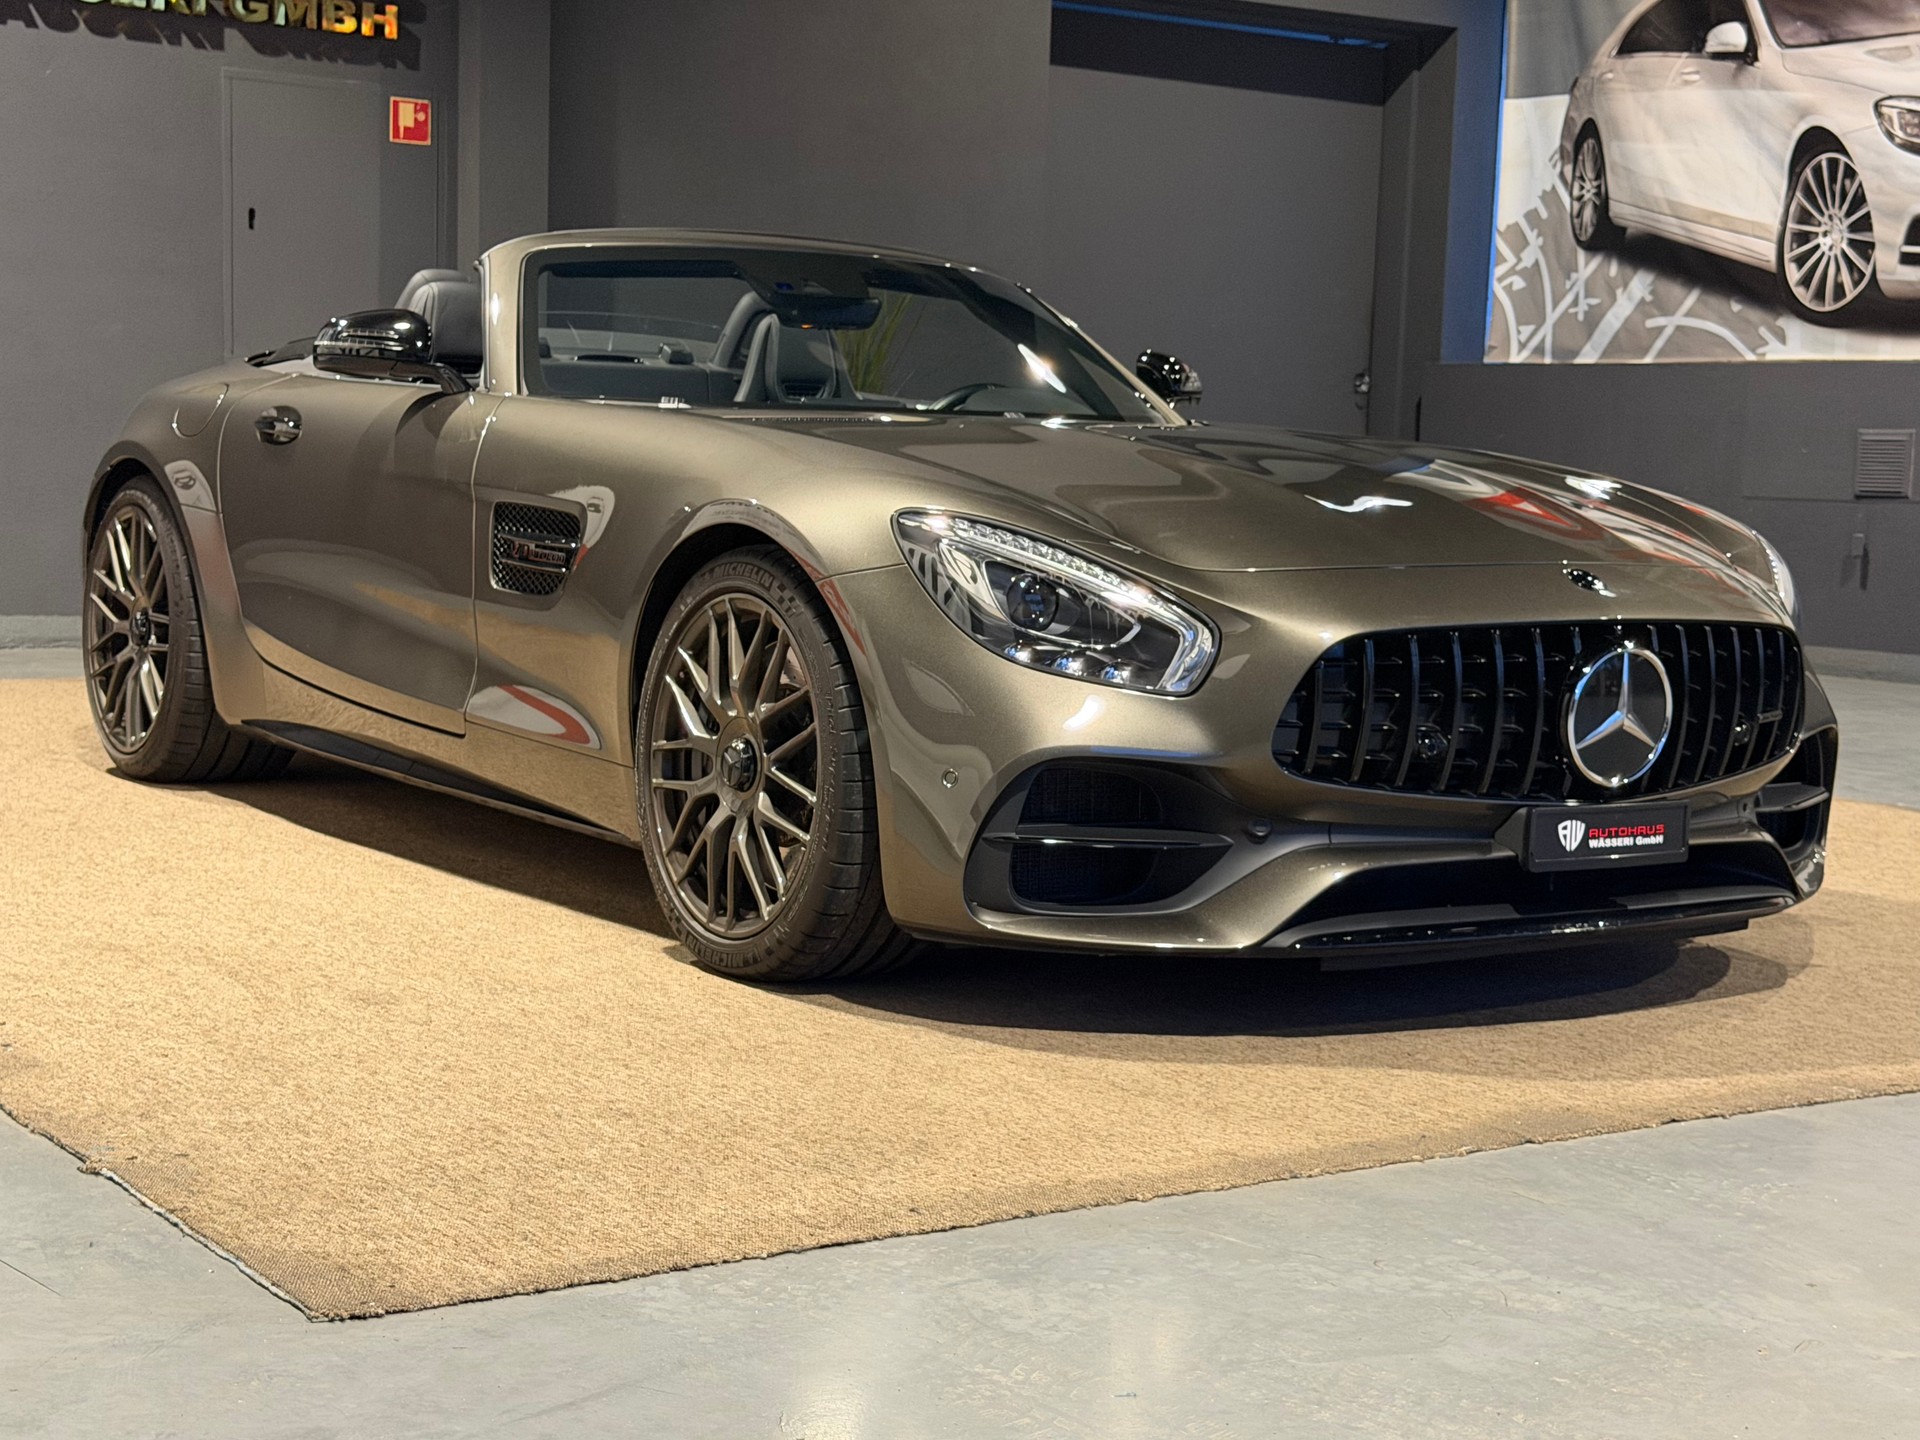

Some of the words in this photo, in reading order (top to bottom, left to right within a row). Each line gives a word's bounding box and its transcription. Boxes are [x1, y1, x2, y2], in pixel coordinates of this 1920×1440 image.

[226, 0, 398, 40] GMBH
[713, 561, 775, 589] MICHELIN
[1588, 824, 1665, 838] AUTOHAUS
[1635, 834, 1664, 846] GmbH
